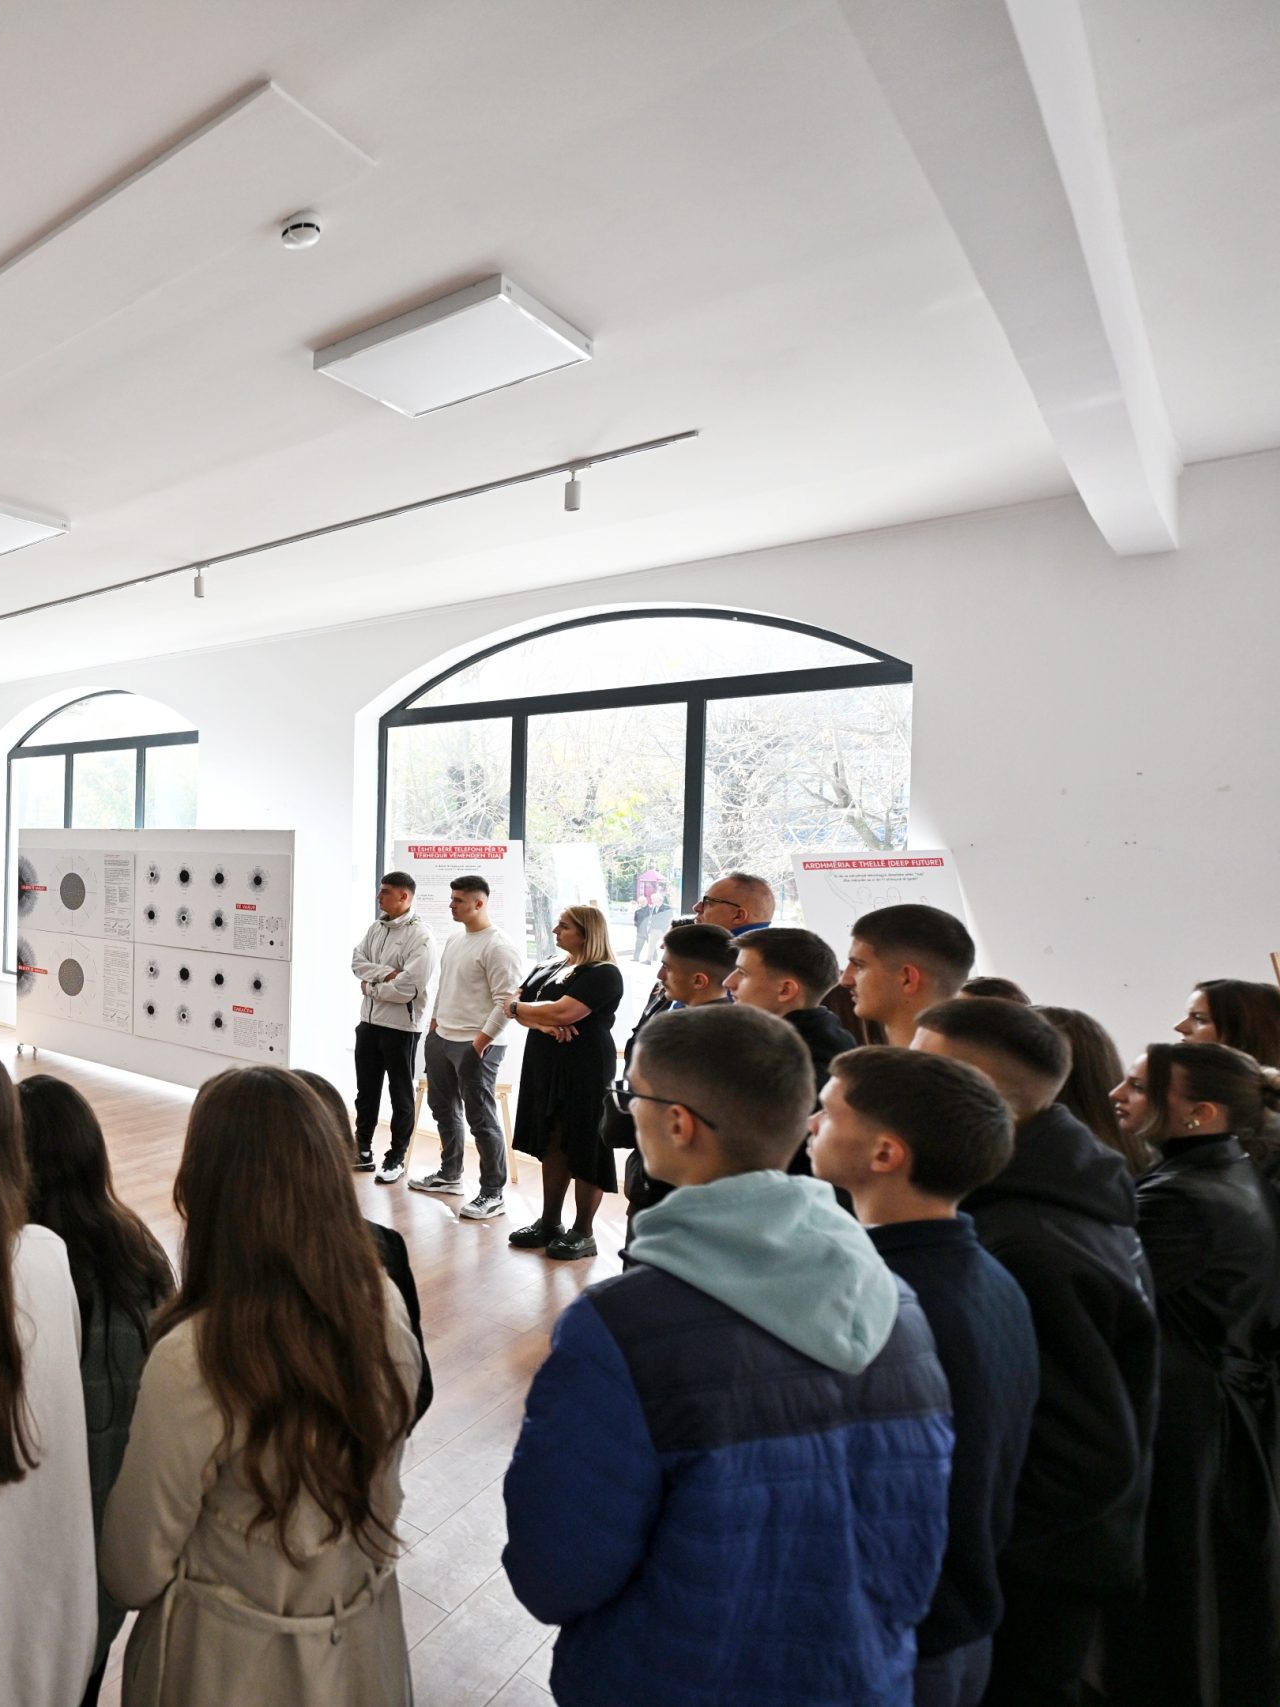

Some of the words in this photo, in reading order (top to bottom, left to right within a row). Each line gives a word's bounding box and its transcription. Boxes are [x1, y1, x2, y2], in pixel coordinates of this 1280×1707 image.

[804, 861, 850, 870] ARDHMËRIA
[860, 860, 886, 868] THELLË
[888, 859, 909, 868] (DEEP
[911, 858, 943, 867] FUTURE)
